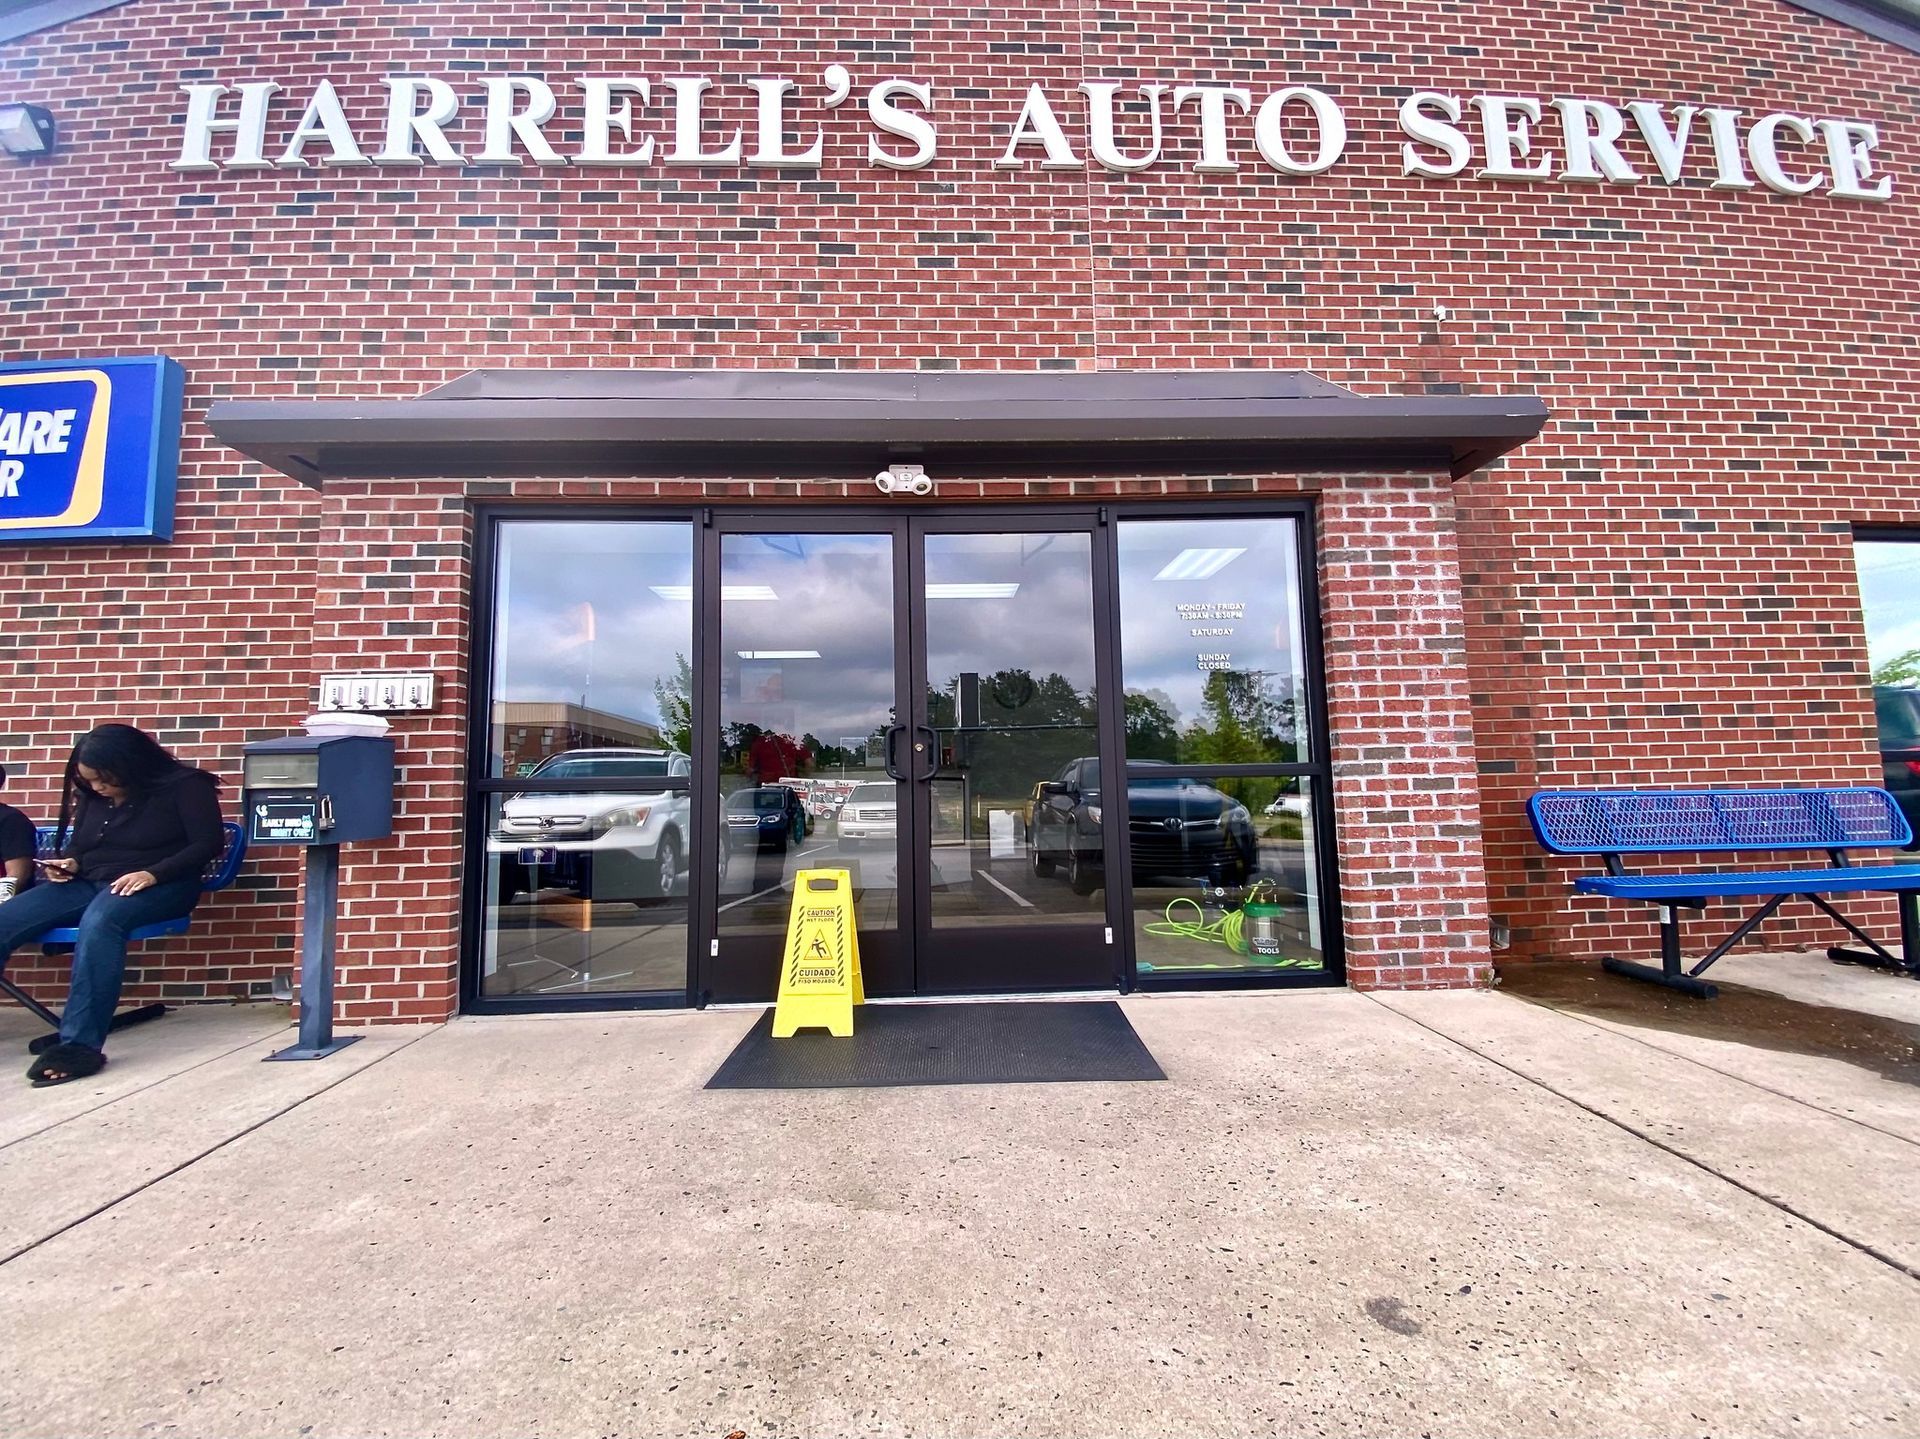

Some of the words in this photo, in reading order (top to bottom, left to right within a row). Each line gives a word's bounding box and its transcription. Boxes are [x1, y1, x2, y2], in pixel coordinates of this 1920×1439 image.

[168, 63, 939, 172] HARRELL'S
[994, 81, 1348, 176] AUTO
[1401, 90, 1893, 201] SERVICE
[0, 408, 77, 455] ARE
[1176, 603, 1211, 612] MONDAY
[1216, 602, 1246, 611] FRIDAY
[1191, 628, 1234, 637] SATURDAY
[1197, 653, 1231, 662] SUNDAY
[1197, 661, 1231, 670] CLOSED
[1257, 947, 1280, 955] TOOLS
[798, 969, 836, 977] CUIDADO
